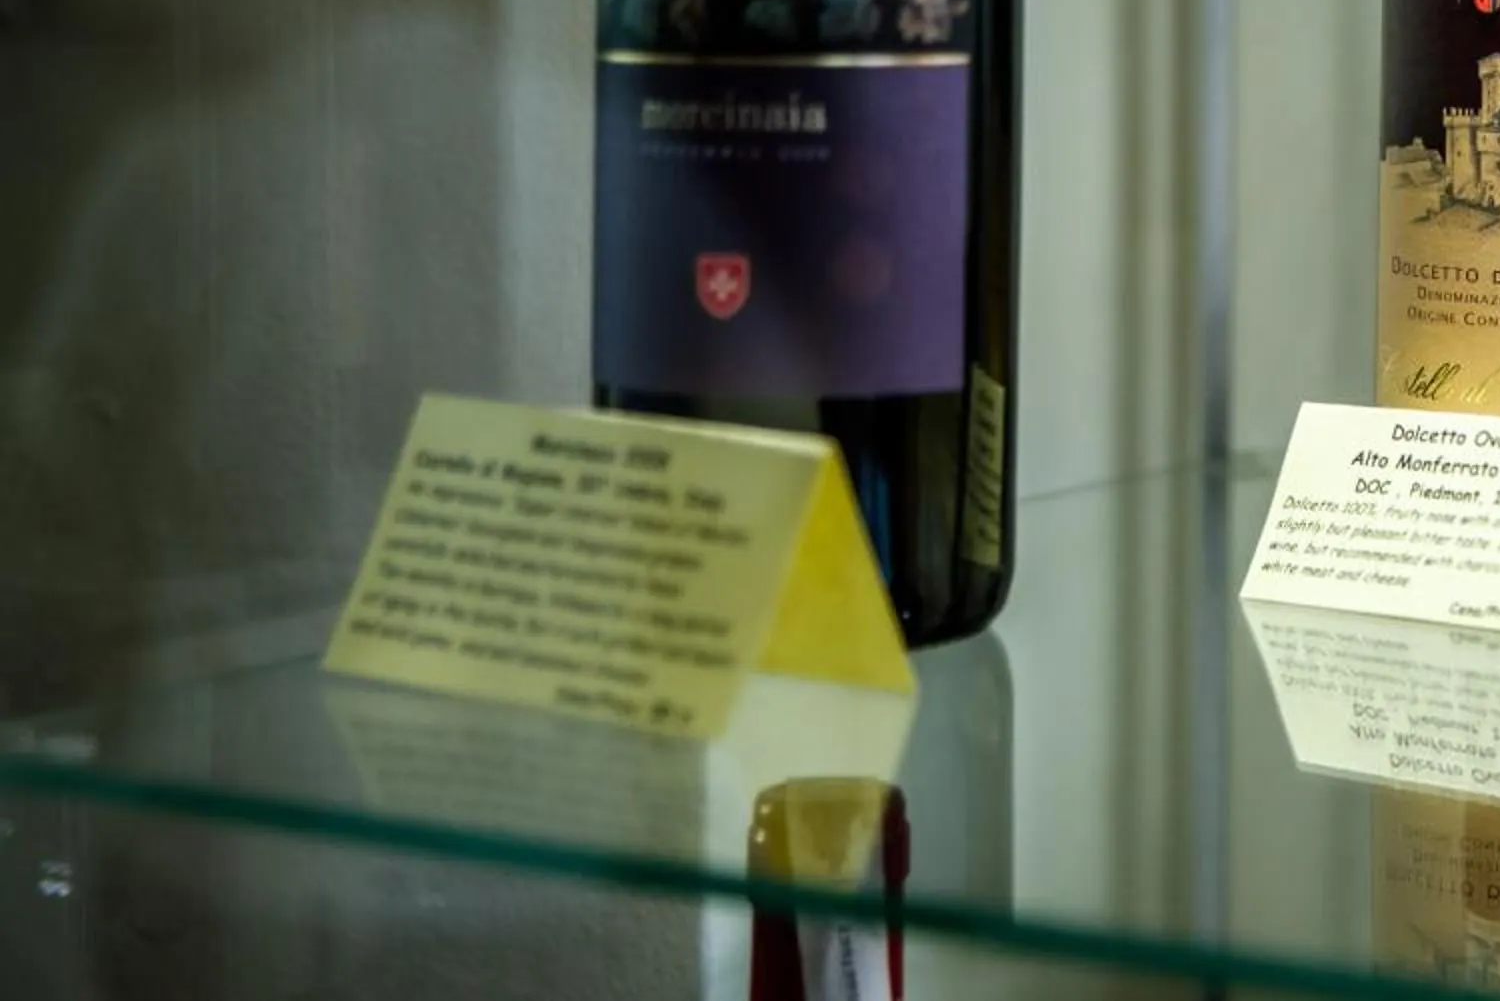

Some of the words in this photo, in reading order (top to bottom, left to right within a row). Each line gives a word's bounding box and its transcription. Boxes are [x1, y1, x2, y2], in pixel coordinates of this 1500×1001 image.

[1391, 256, 1479, 284] DOLCETTO
[1407, 305, 1456, 325] ORIGINE
[1392, 423, 1467, 446] Dolcetto
[1351, 449, 1390, 468] Alto
[1395, 453, 1499, 478] Monferrato
[1355, 478, 1392, 496] DOC
[1409, 482, 1484, 505] Piedmont,
[1283, 495, 1339, 513] Dolcetto
[1275, 516, 1322, 535] slightly
[1326, 522, 1350, 536] but
